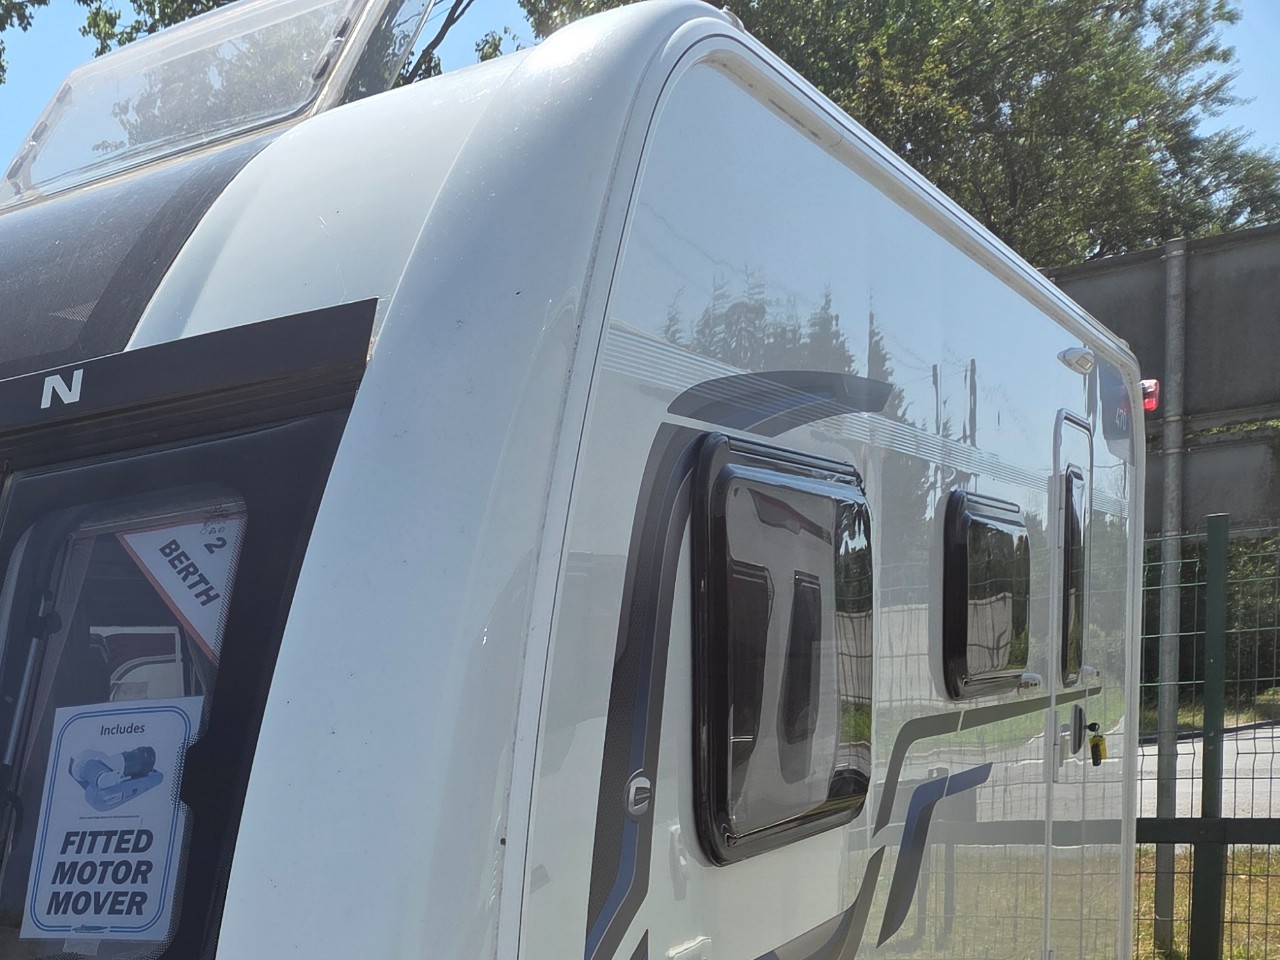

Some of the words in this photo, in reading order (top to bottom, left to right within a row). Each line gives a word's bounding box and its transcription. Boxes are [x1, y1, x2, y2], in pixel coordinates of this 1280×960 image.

[203, 536, 228, 555] 2
[158, 538, 221, 608] BERTH
[100, 721, 146, 736] Includes
[60, 829, 154, 855] FITTED
[51, 859, 154, 886] MOTOR
[46, 890, 149, 916] MOVER
